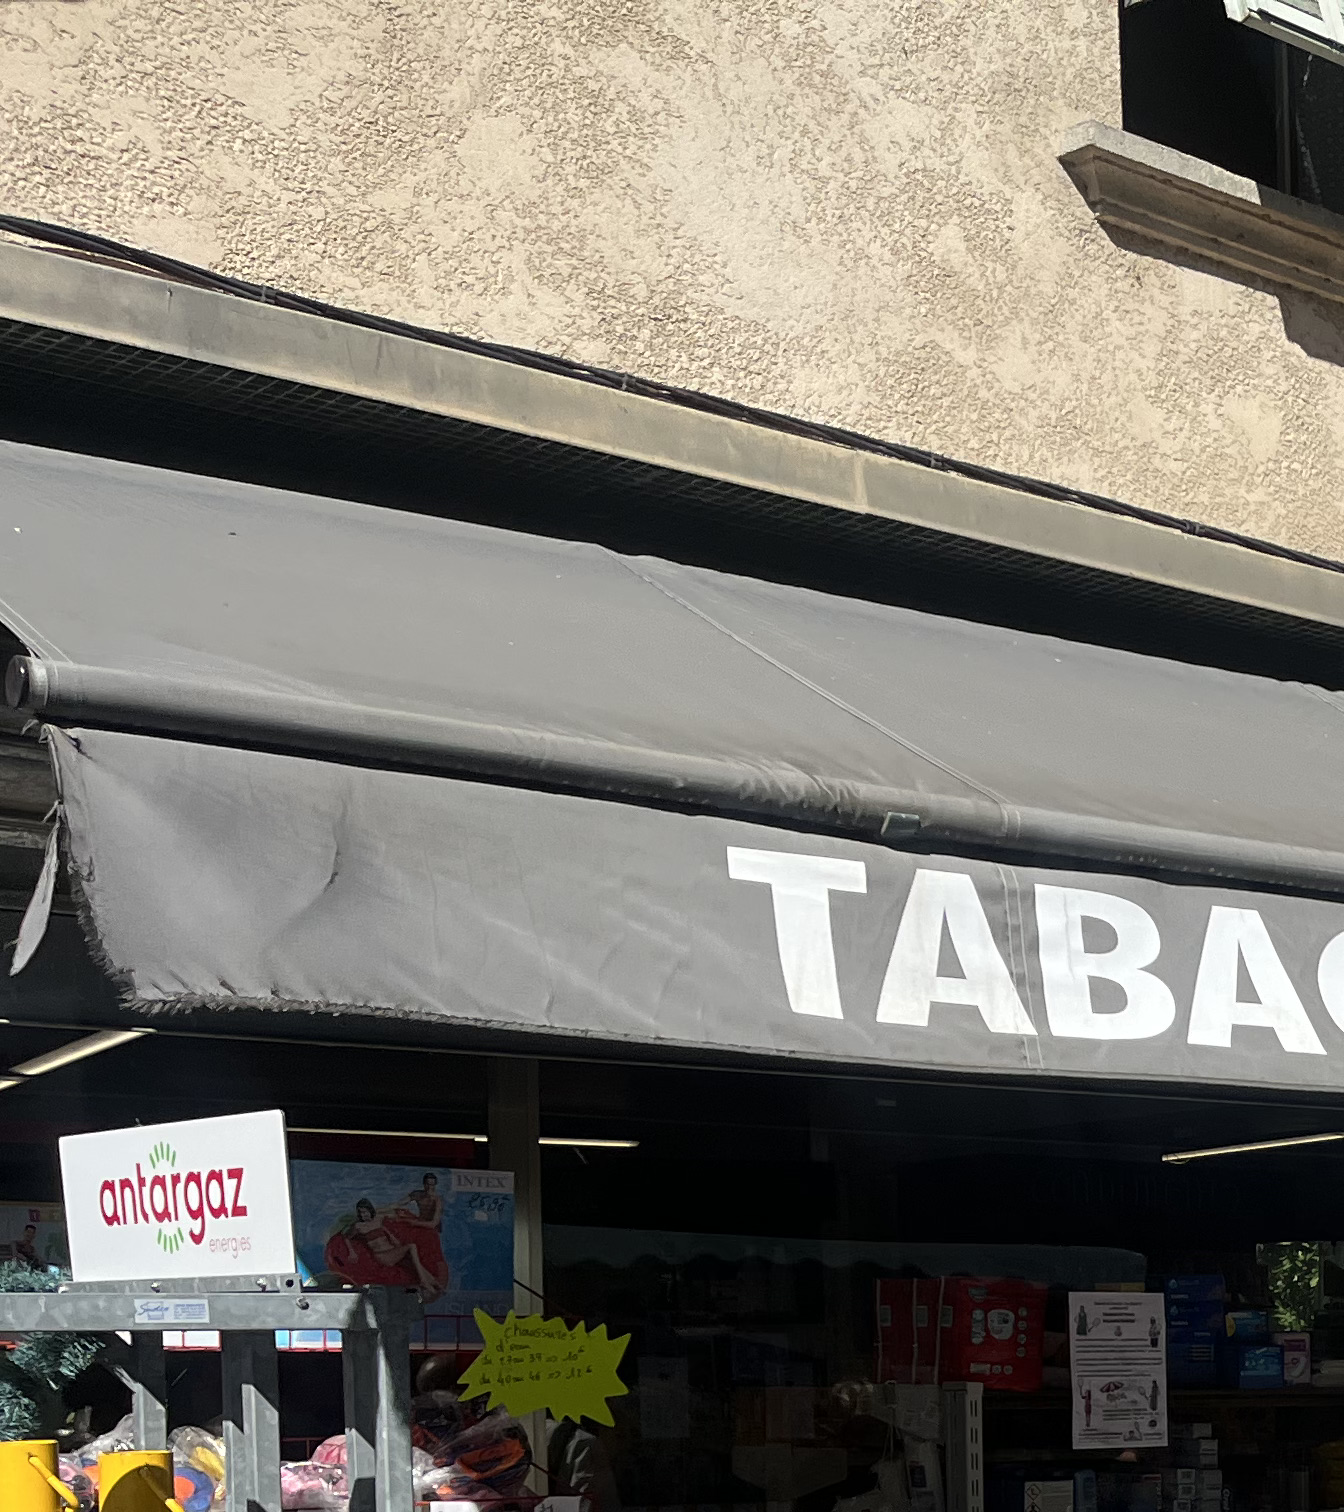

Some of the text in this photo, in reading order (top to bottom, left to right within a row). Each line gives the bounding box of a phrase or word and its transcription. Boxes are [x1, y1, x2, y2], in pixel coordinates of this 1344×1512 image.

[456, 1174, 506, 1189] INTEX
[99, 1162, 248, 1246] antargaz
[209, 1234, 252, 1259] energies
